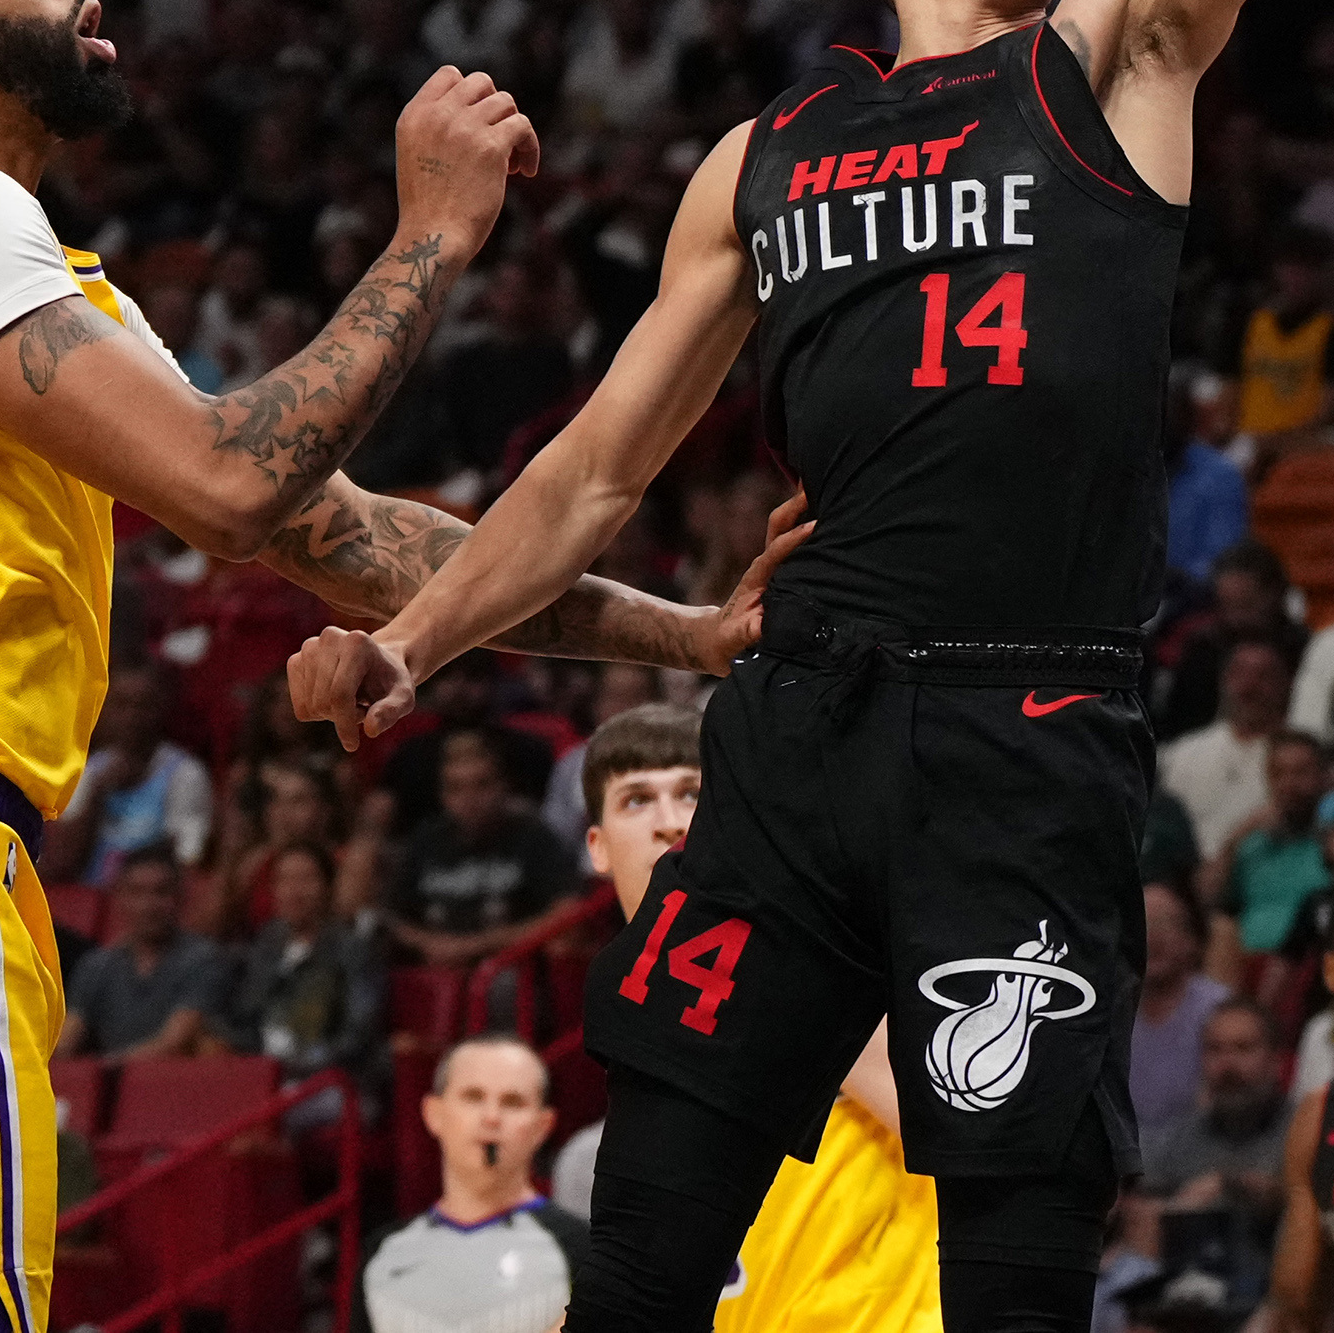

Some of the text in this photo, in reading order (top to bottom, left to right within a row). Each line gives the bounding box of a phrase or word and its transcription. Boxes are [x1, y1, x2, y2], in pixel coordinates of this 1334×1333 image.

[787, 120, 979, 202] HEAT
[752, 175, 1034, 302] CULTURE
[911, 273, 1028, 387] 14
[618, 889, 752, 1035] 14
